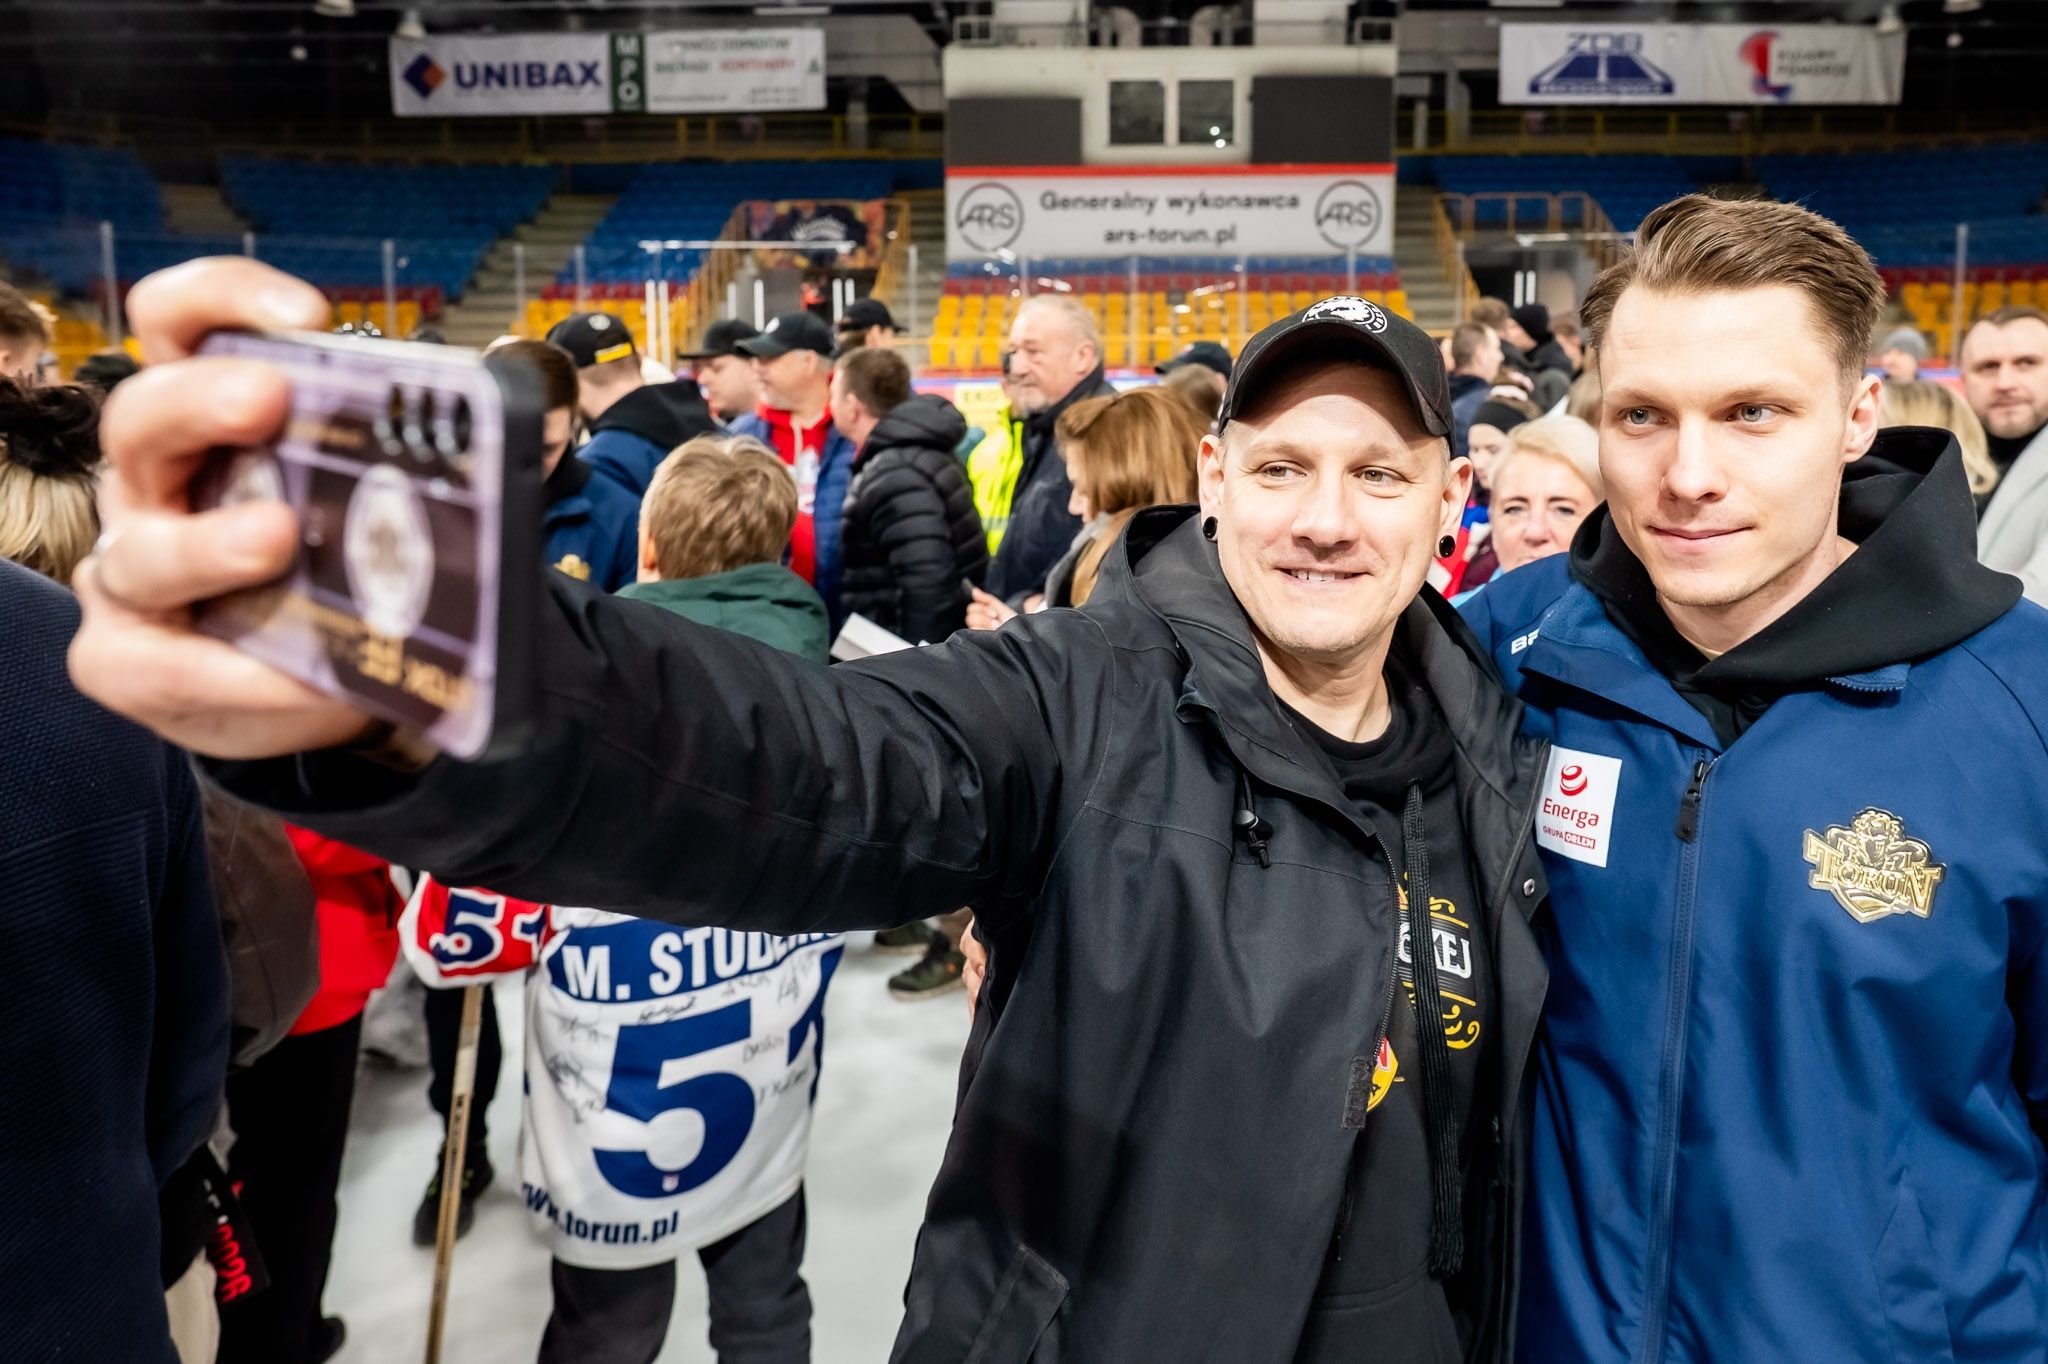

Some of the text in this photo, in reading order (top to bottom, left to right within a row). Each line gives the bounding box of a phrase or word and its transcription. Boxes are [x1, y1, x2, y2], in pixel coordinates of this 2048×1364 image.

[455, 61, 602, 89] UNIBAX
[615, 37, 640, 102] MPO
[958, 202, 1016, 231] ARS
[1040, 189, 1301, 216] Generalny wykonawca
[1316, 200, 1374, 227] ARS
[1103, 225, 1238, 245] ars-torun.pl
[1543, 797, 1599, 828] Energa
[1543, 826, 1595, 849] GRUPA ORLEN
[561, 944, 631, 1000] M.
[650, 926, 838, 996] STUD
